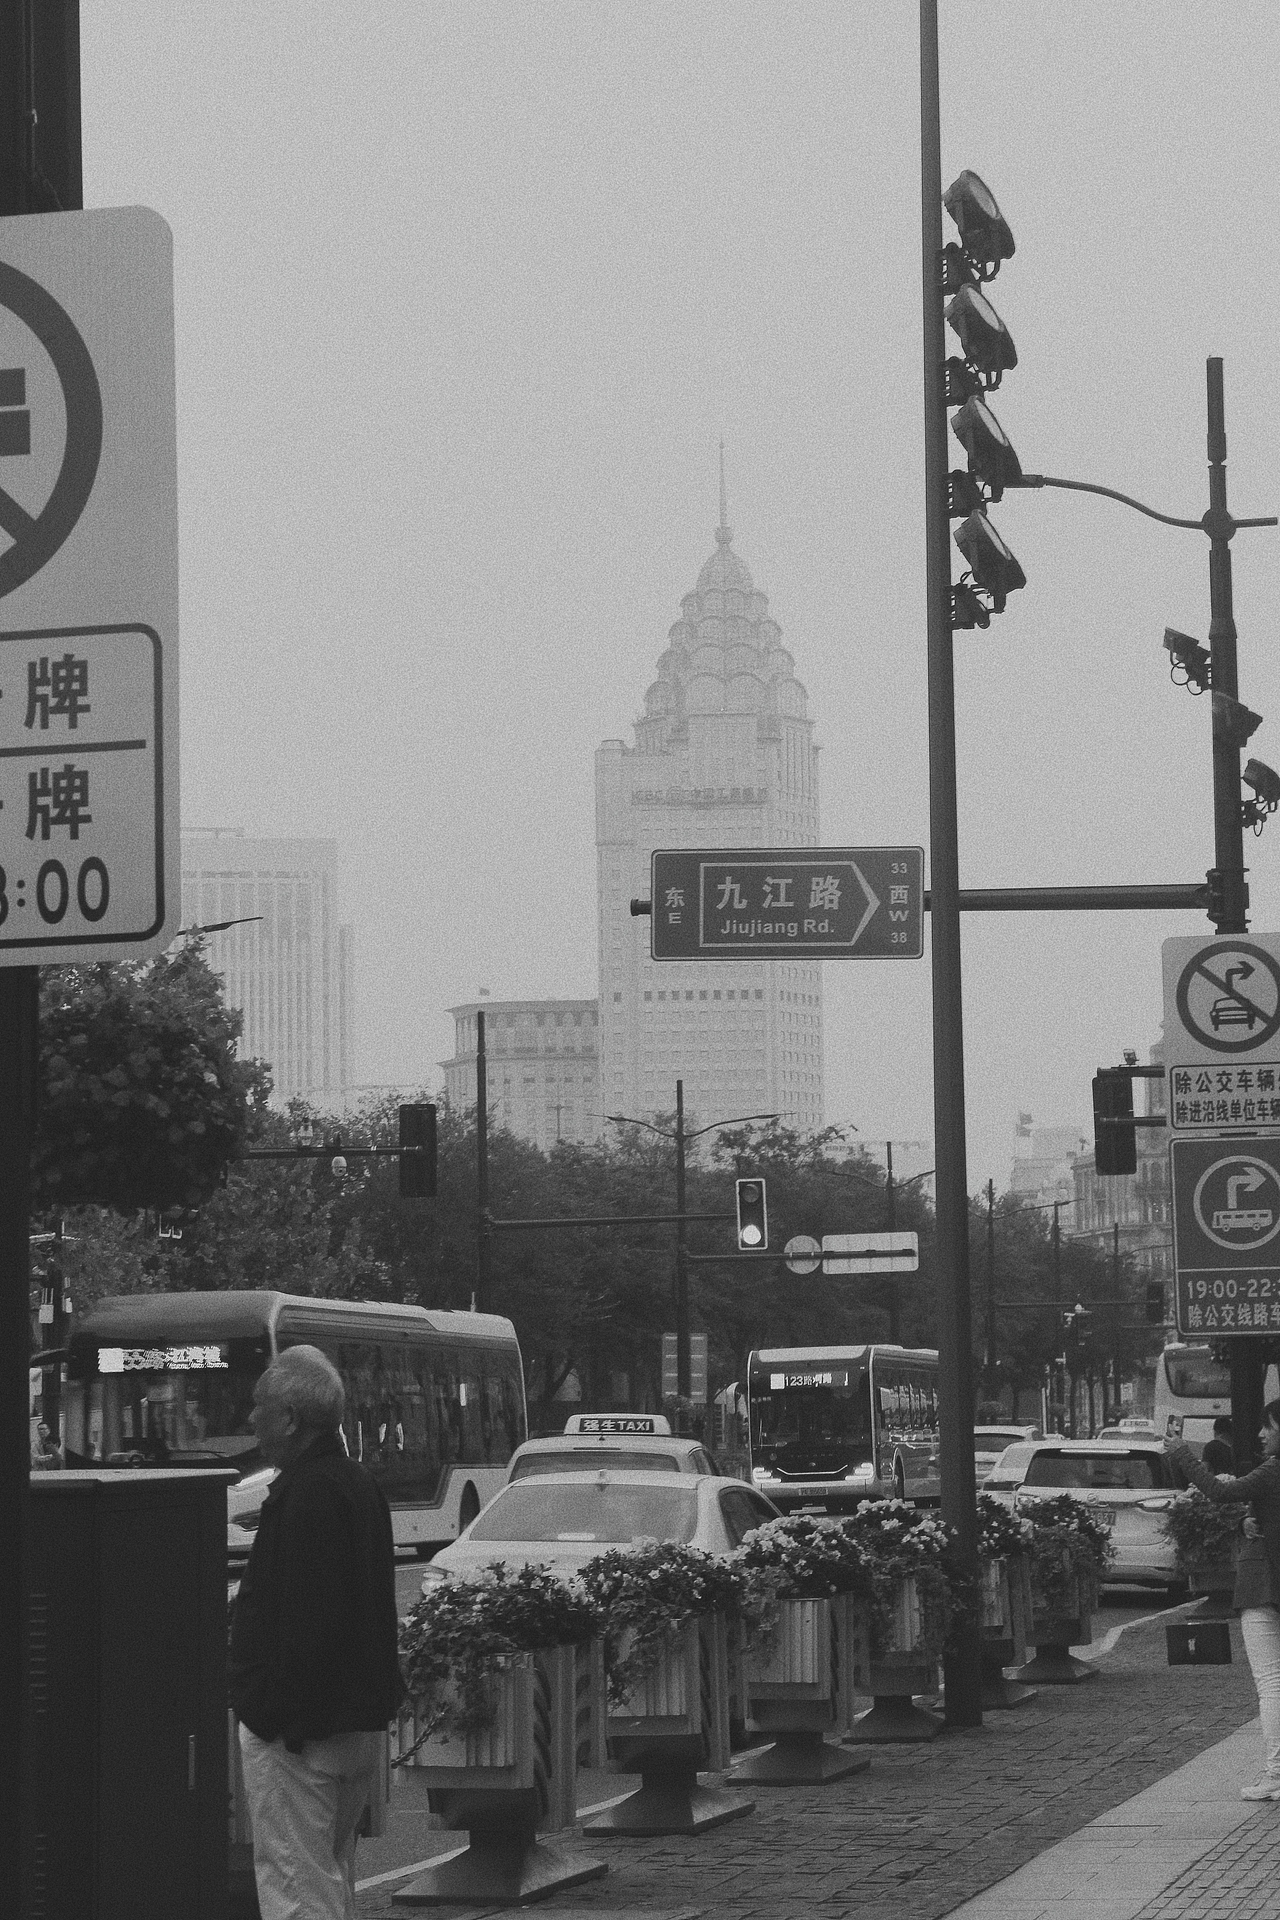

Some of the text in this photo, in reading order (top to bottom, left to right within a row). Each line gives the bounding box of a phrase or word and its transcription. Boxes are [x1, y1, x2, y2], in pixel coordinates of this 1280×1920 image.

[0, 653, 91, 730] 牌
[0, 764, 93, 841] 牌
[891, 862, 908, 875] 33
[0, 856, 110, 927] :00
[664, 886, 686, 909] 东
[715, 875, 843, 910] 九江路
[889, 884, 910, 905] 西
[668, 912, 682, 924] E
[889, 910, 909, 922] W
[720, 918, 835, 937] Jiujiang Rd.
[891, 932, 908, 944] 38
[1174, 1068, 1280, 1096] 除公交车辆
[1187, 1278, 1280, 1300] 19:00-22:
